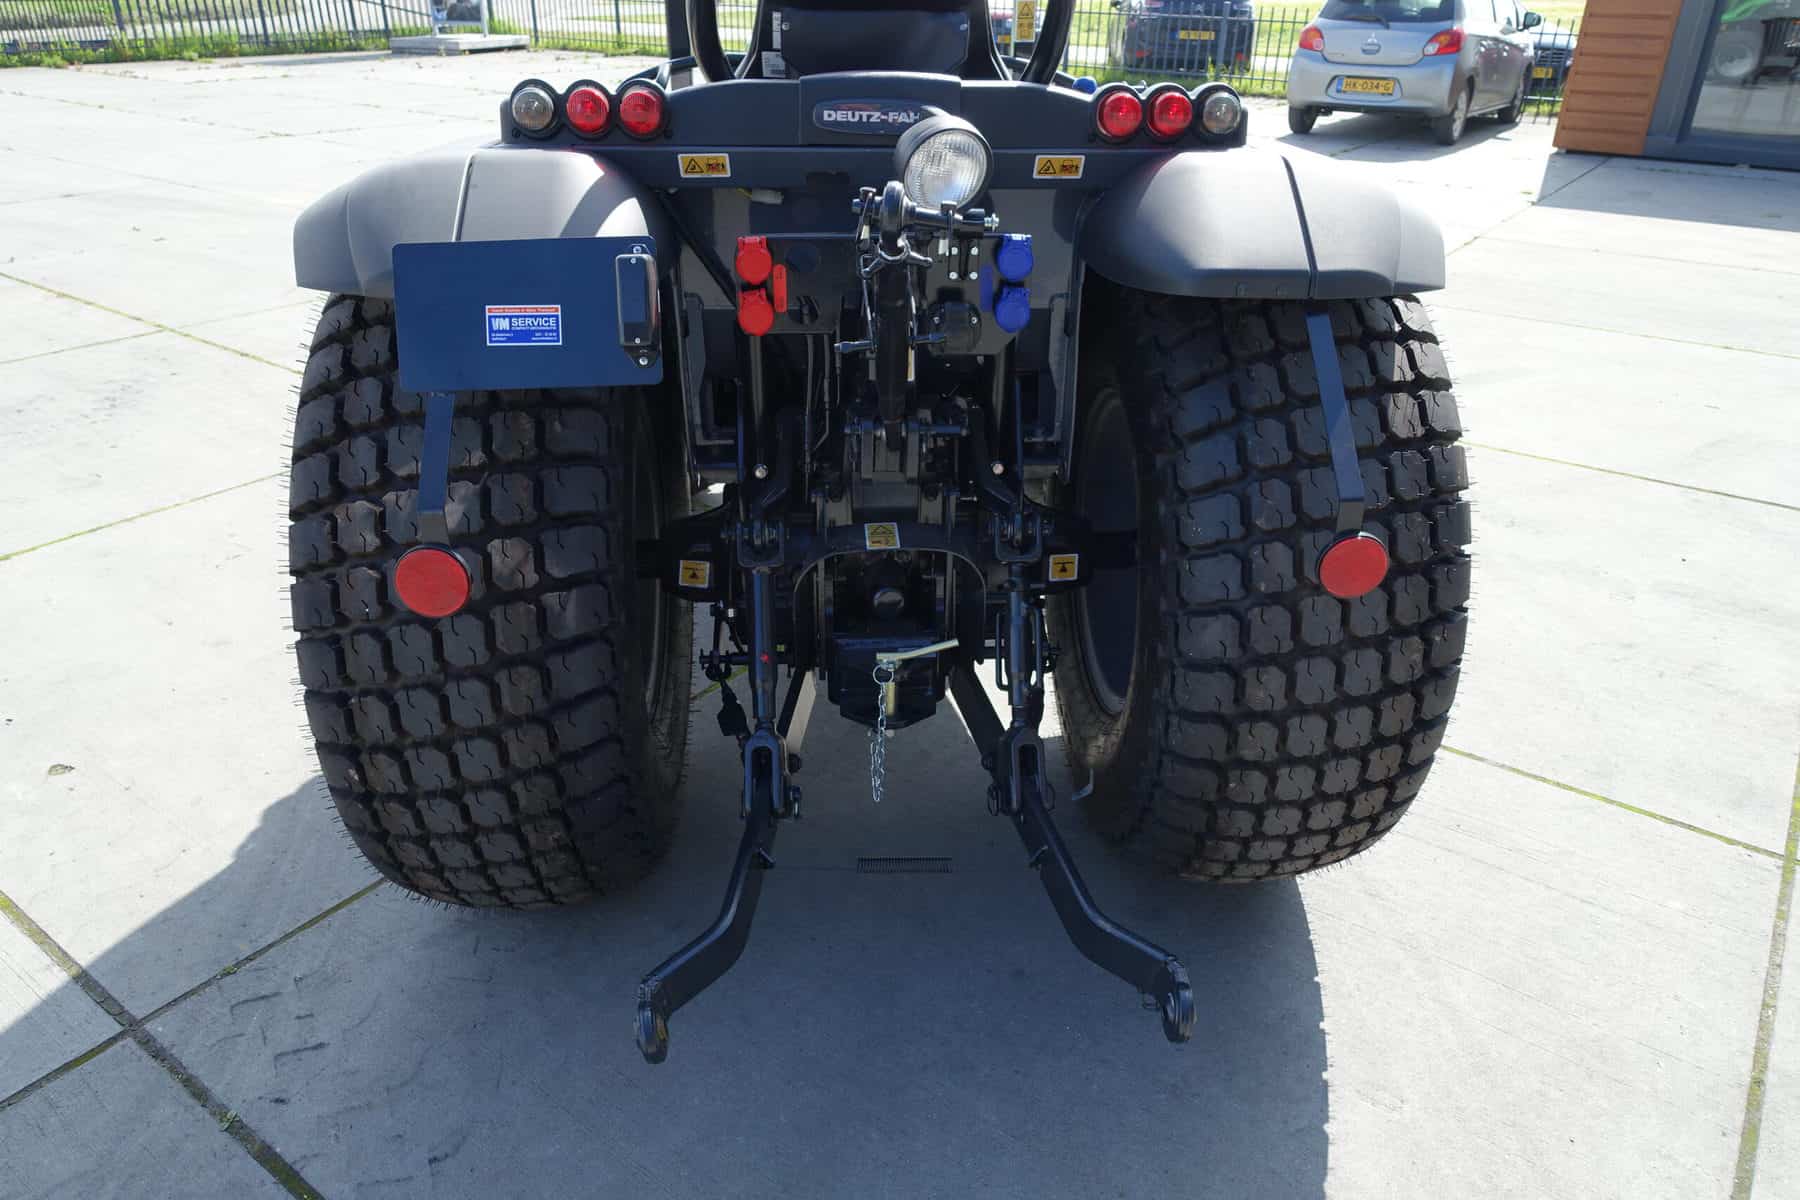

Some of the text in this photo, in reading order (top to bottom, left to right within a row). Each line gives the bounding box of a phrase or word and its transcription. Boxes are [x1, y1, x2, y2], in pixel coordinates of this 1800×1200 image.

[1344, 80, 1392, 91] HK-034-G
[823, 110, 920, 123] DEUTZ-FAH
[491, 317, 557, 331] VM SERVICE
